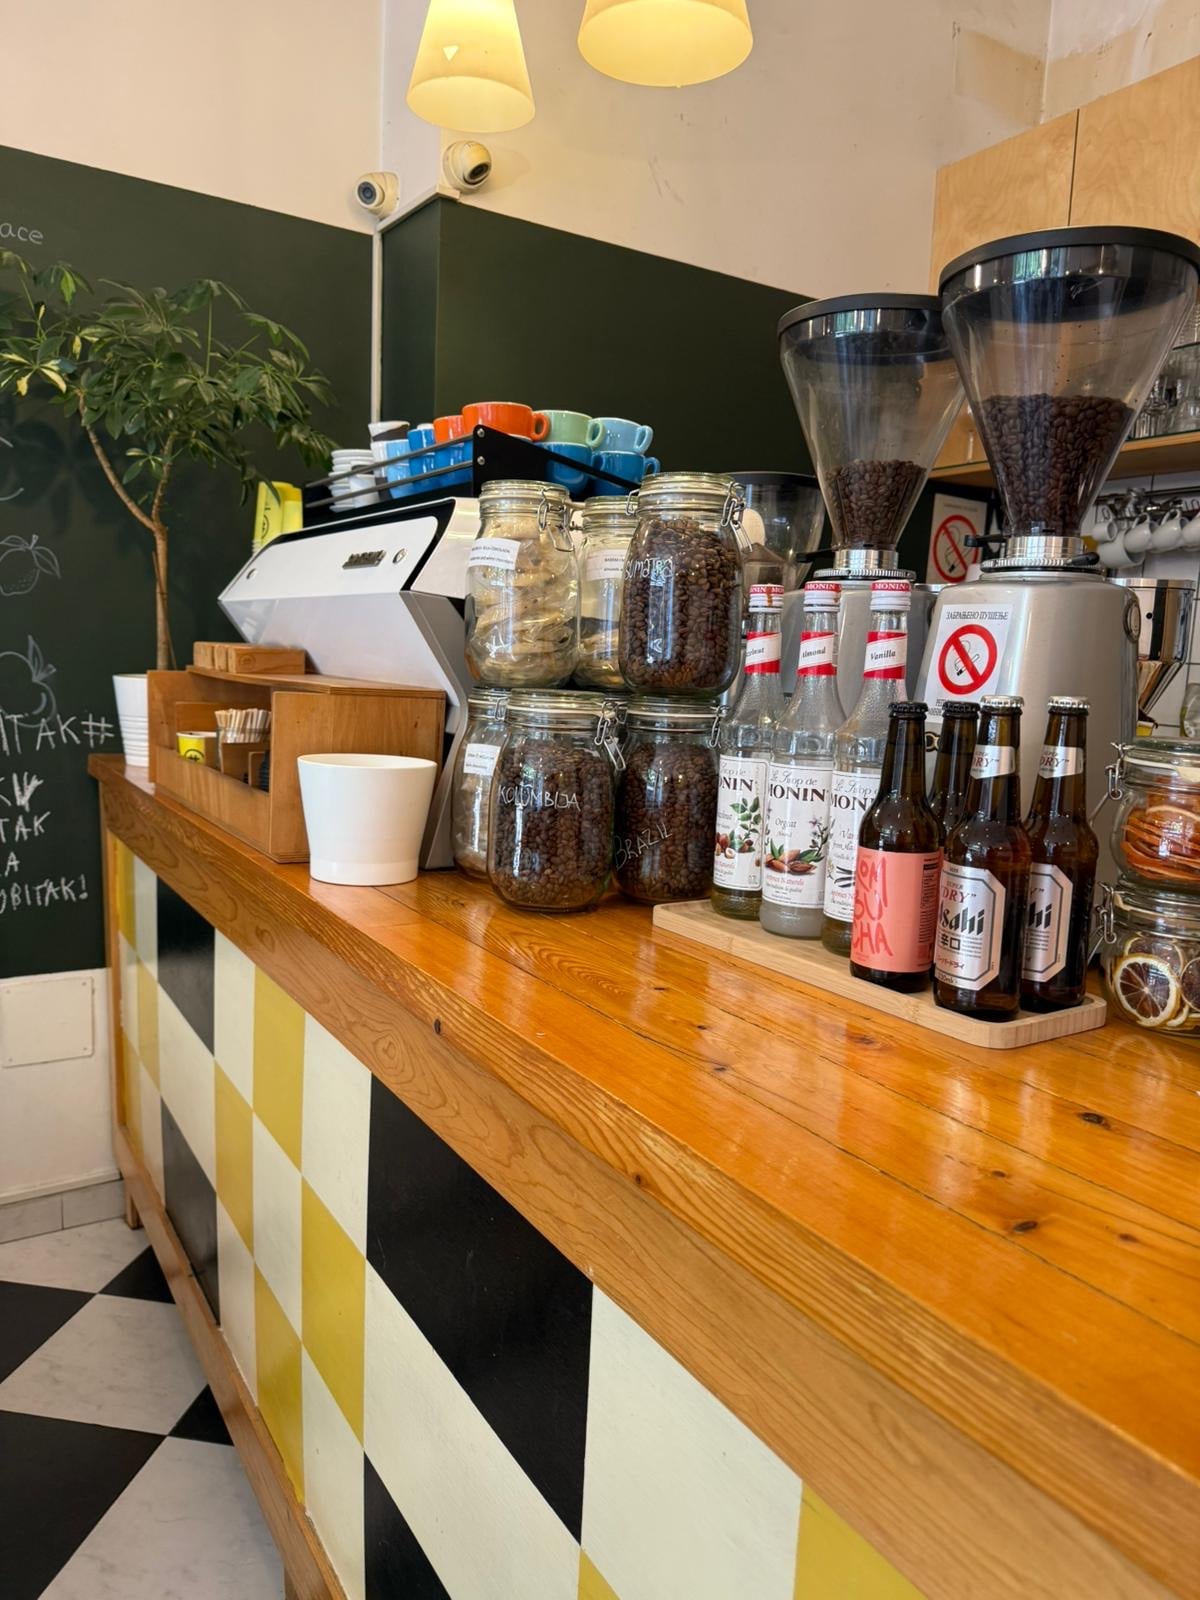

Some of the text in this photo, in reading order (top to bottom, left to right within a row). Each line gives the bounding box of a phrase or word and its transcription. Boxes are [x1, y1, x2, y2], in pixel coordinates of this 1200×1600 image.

[875, 583, 907, 592] MONIN
[802, 646, 826, 658] Almond
[870, 649, 896, 660] Vanilla
